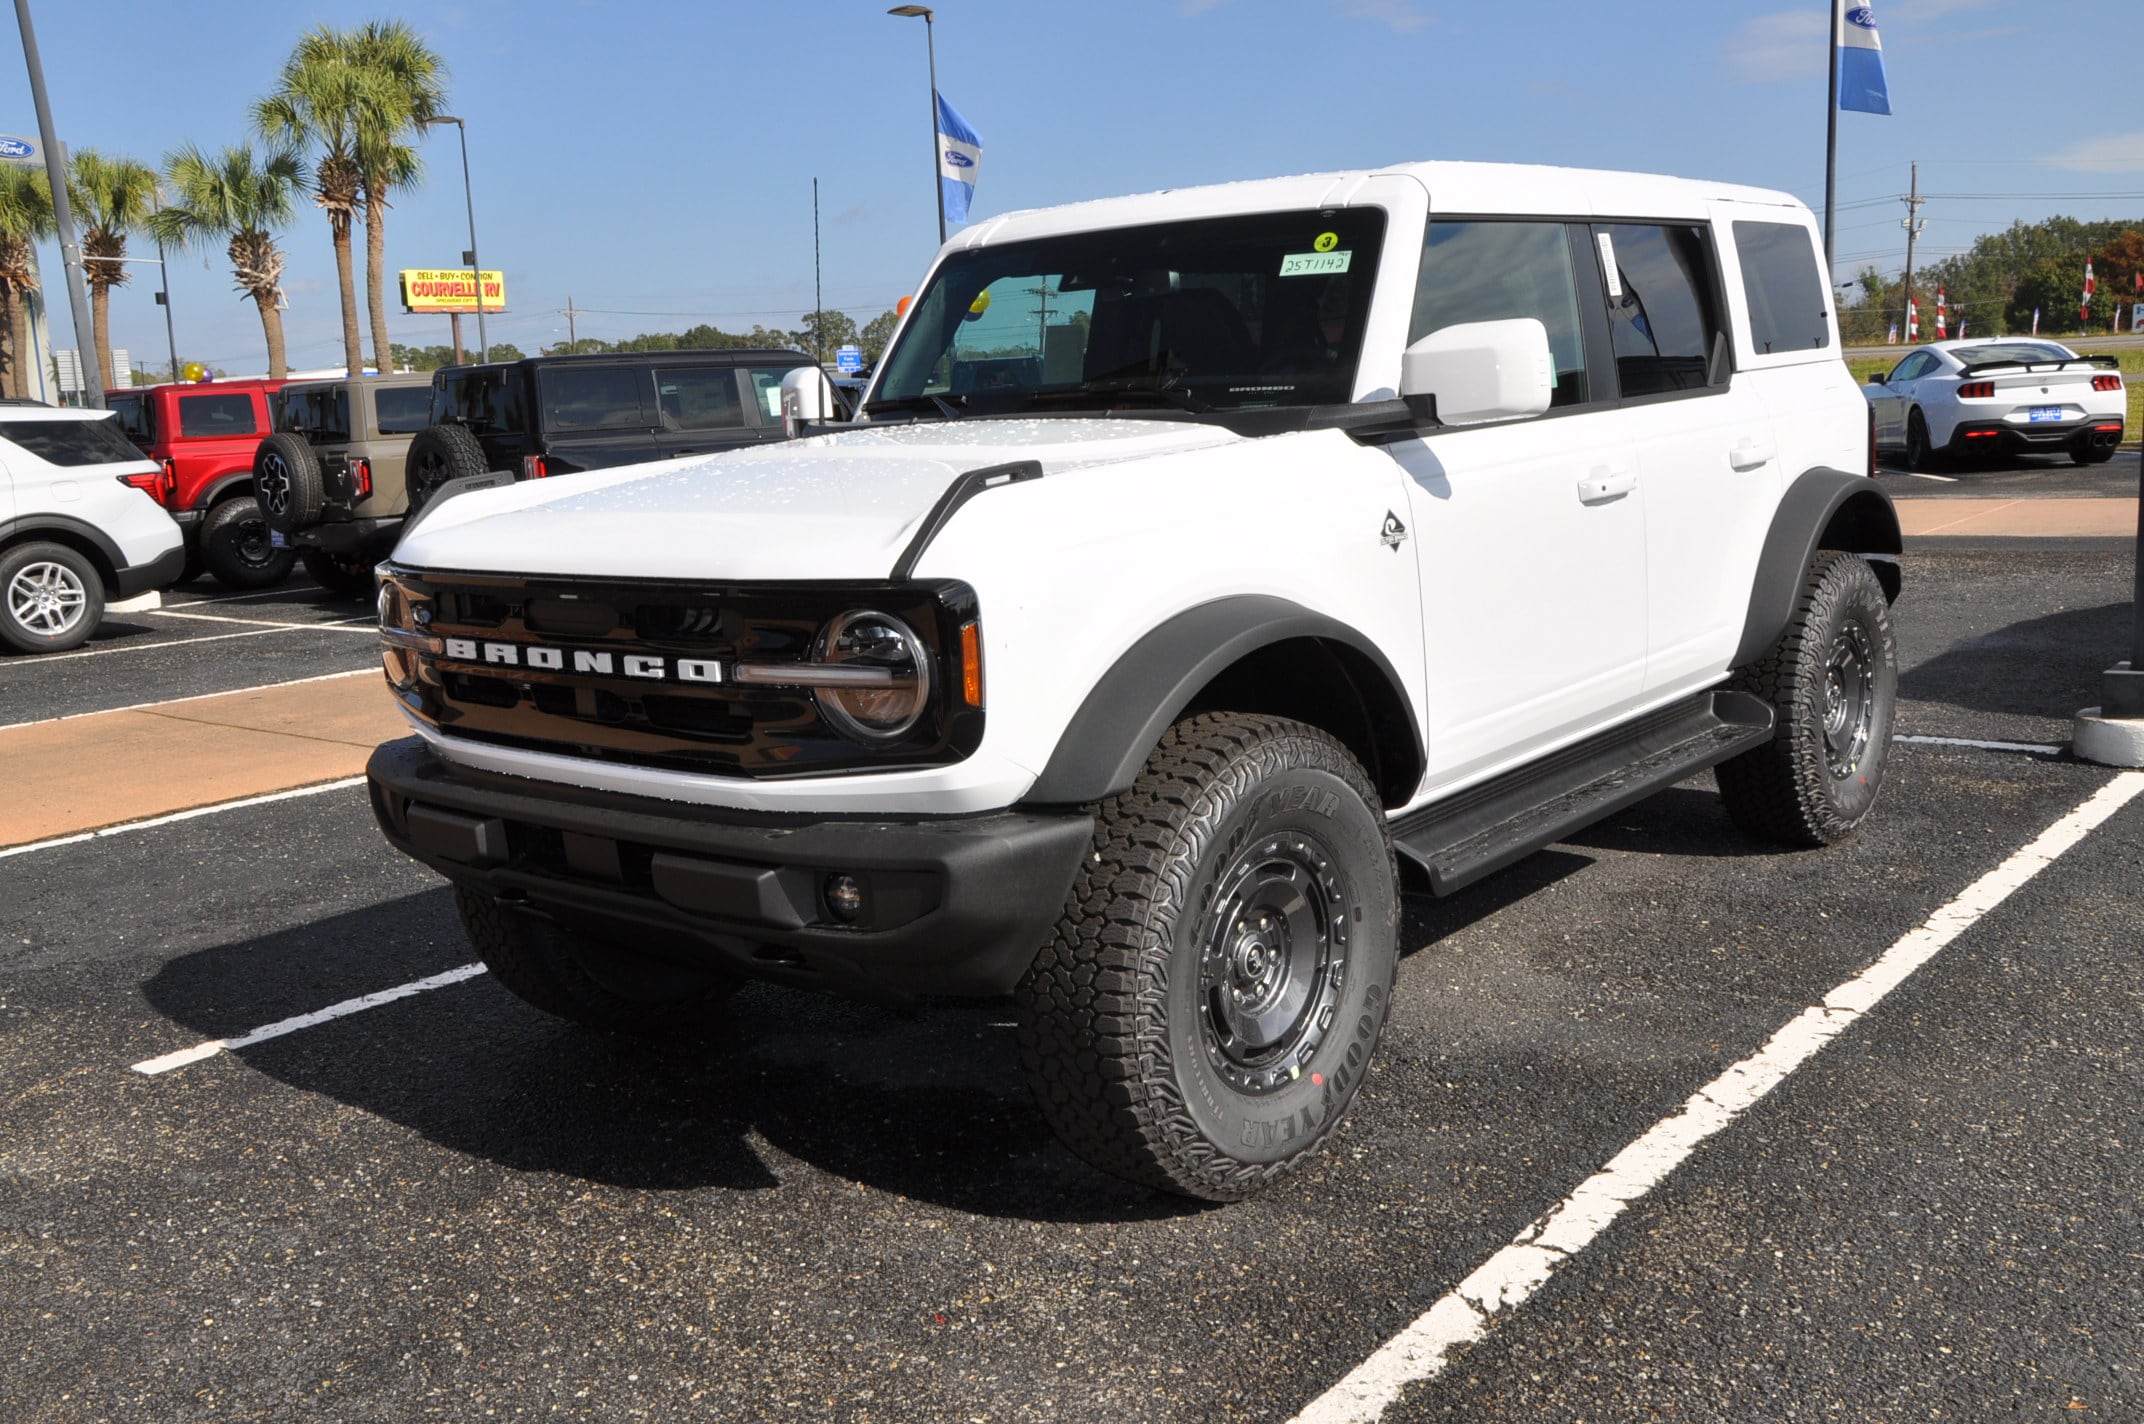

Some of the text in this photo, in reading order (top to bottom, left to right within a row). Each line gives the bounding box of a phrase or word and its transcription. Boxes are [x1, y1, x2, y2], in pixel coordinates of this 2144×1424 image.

[1856, 9, 1876, 25] For
[946, 152, 968, 166] Ford
[1322, 236, 1332, 248] 3
[417, 272, 493, 281] SELL BUY CONIGN
[484, 282, 500, 297] RV
[445, 638, 722, 683] BRONCO
